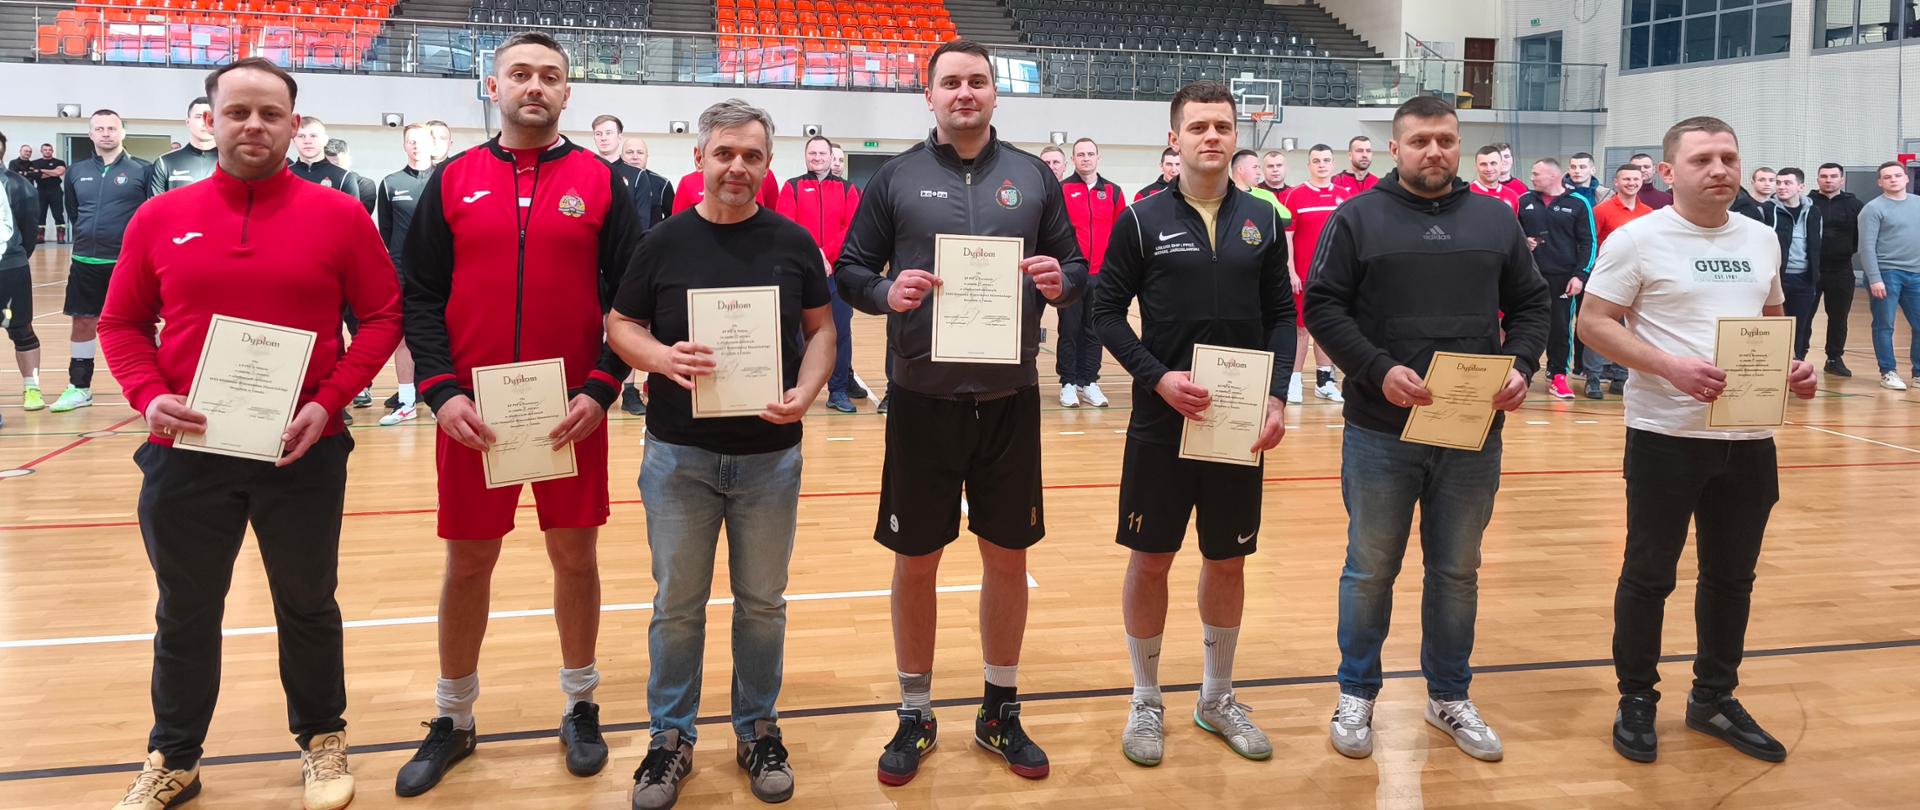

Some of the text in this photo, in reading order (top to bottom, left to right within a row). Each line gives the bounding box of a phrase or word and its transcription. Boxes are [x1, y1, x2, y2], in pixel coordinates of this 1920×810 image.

[963, 247, 997, 259] Dyplom
[1694, 260, 1752, 272] GUESS
[717, 299, 751, 312] Dyplom
[1740, 327, 1771, 338] Dyplom
[241, 332, 280, 348] Dyplom
[1217, 357, 1247, 369] Dyplom
[503, 374, 538, 387] Dyplom
[1127, 511, 1144, 534] 11
